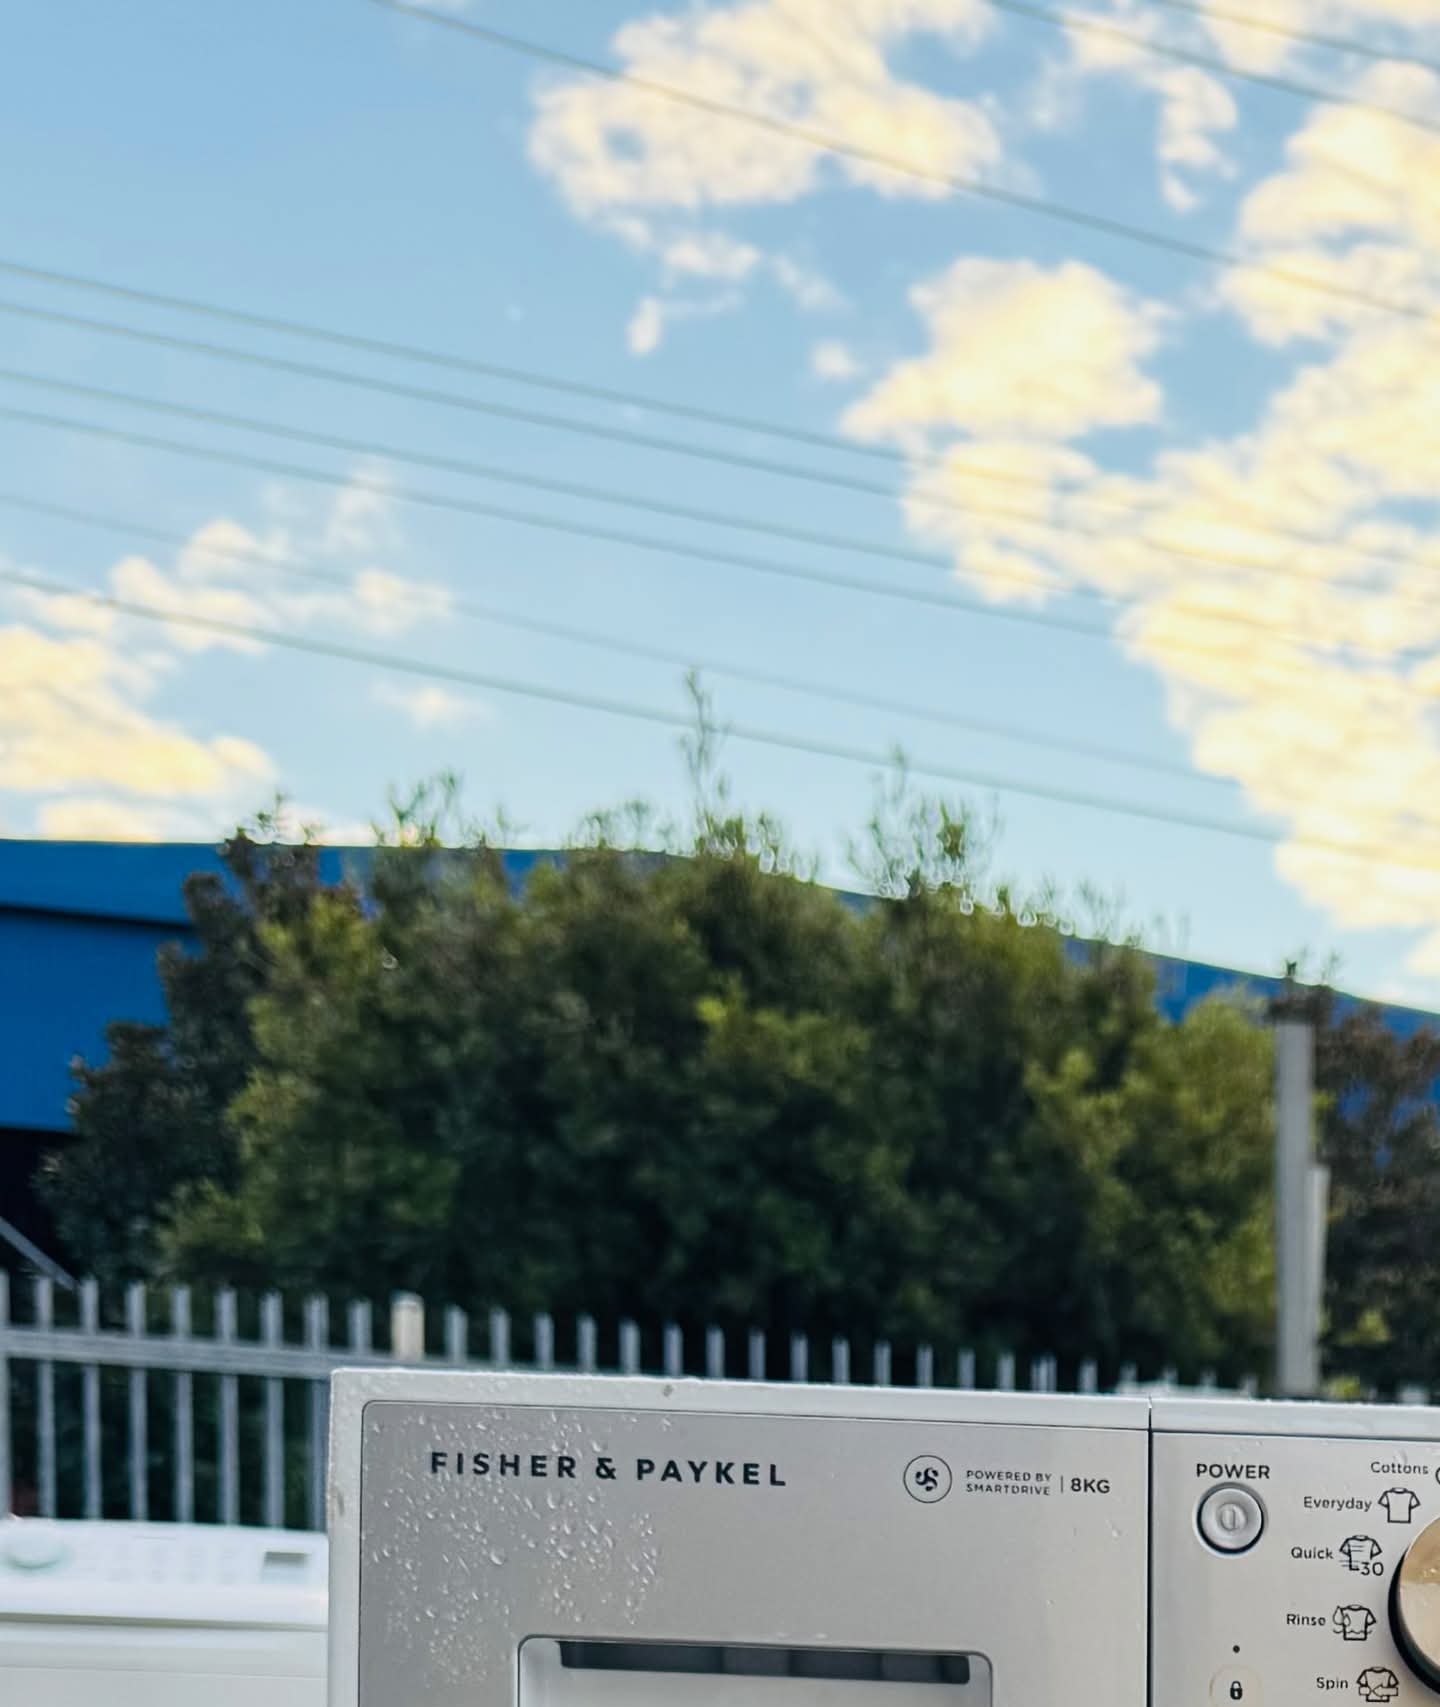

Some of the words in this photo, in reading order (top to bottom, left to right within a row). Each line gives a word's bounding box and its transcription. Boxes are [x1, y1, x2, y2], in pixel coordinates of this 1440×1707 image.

[429, 1452, 576, 1479] FISHER
[595, 1457, 617, 1481] &
[636, 1458, 787, 1487] PAYKEL
[1197, 1464, 1270, 1479] POWER
[1371, 1461, 1428, 1475] Cottons
[966, 1470, 1030, 1481] POWERED
[1036, 1473, 1052, 1481] BY
[966, 1484, 1050, 1495] SMARTDRIVE
[1071, 1478, 1110, 1494] 8KG
[1304, 1496, 1372, 1512] Everyday
[1291, 1547, 1333, 1559] Quick
[1361, 1562, 1384, 1576] 30
[1286, 1614, 1326, 1626] Rinse
[1316, 1677, 1348, 1690] Spin
